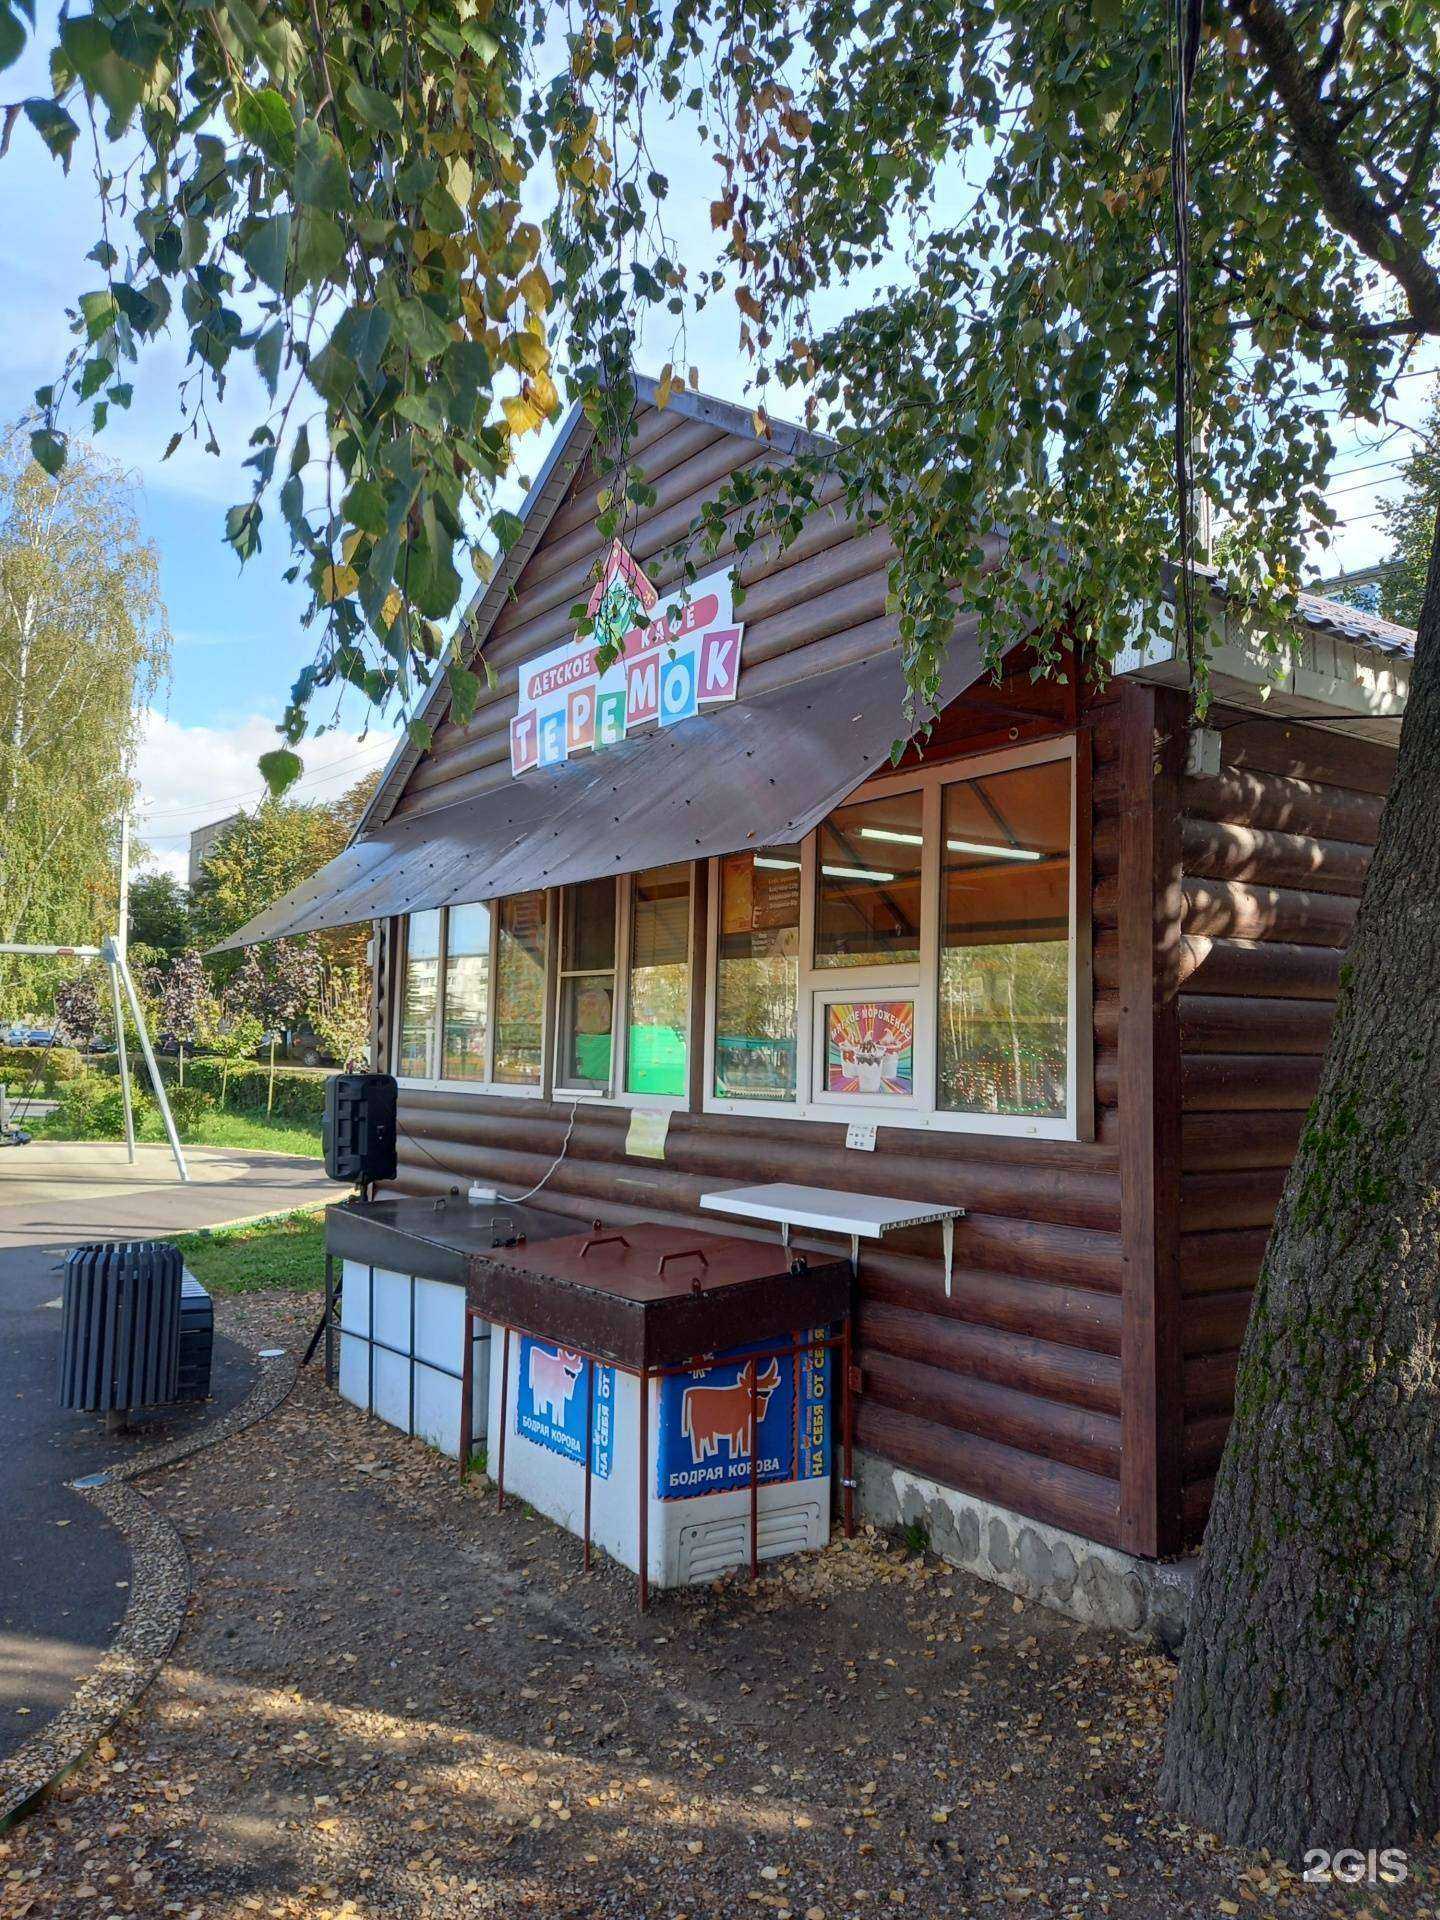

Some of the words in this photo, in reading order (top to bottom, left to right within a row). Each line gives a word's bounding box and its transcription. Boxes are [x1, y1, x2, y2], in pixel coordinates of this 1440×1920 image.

[532, 657, 590, 698] ДЕТСКОЕ
[515, 639, 733, 763] ТЕРЕМОК
[861, 1008, 912, 1039] МОРОЖЕНОЕ
[602, 1374, 610, 1398] ОТ
[813, 1374, 824, 1398] ОТ
[522, 1415, 550, 1438] БОДРАЯ
[551, 1428, 581, 1453] КОРОВА
[600, 1404, 609, 1447] СЕБЯ
[813, 1405, 824, 1446] СЕБЯ
[600, 1452, 608, 1477] НА
[669, 1466, 723, 1487] БОДРАЯ
[813, 1450, 823, 1476] НА
